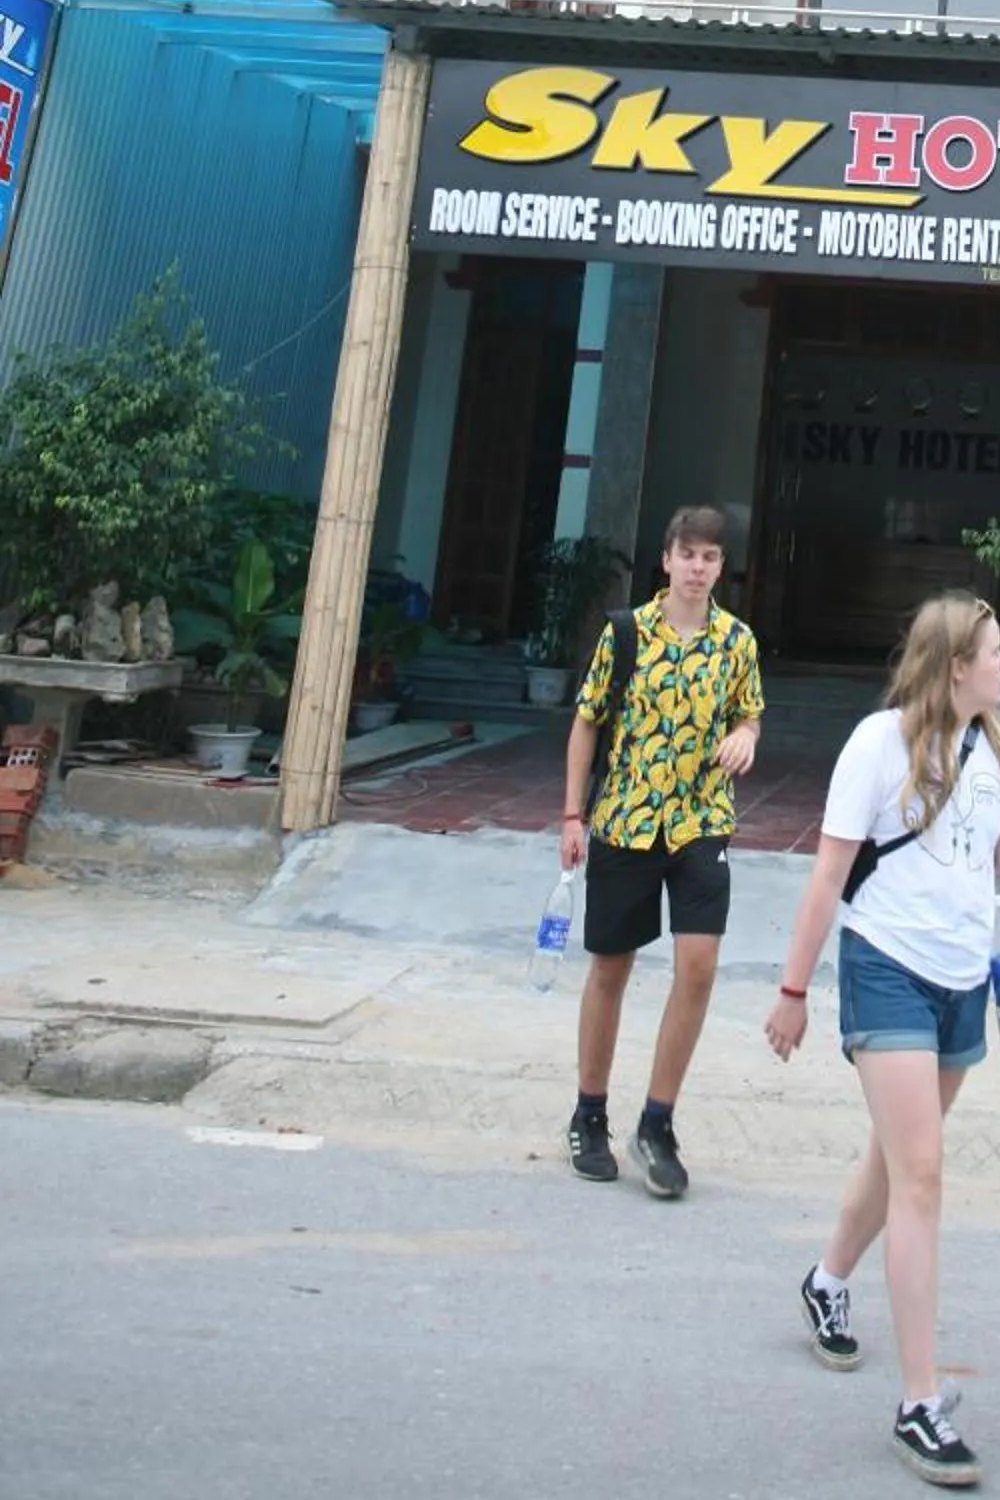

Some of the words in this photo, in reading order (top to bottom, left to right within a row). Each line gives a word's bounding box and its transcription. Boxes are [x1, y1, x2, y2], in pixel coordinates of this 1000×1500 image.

[429, 187, 499, 236] ROOM
[501, 190, 600, 242] SERVICE
[614, 199, 720, 249] BOOKING
[720, 203, 799, 255] OFFICE
[817, 210, 937, 262] MOTOBIKE
